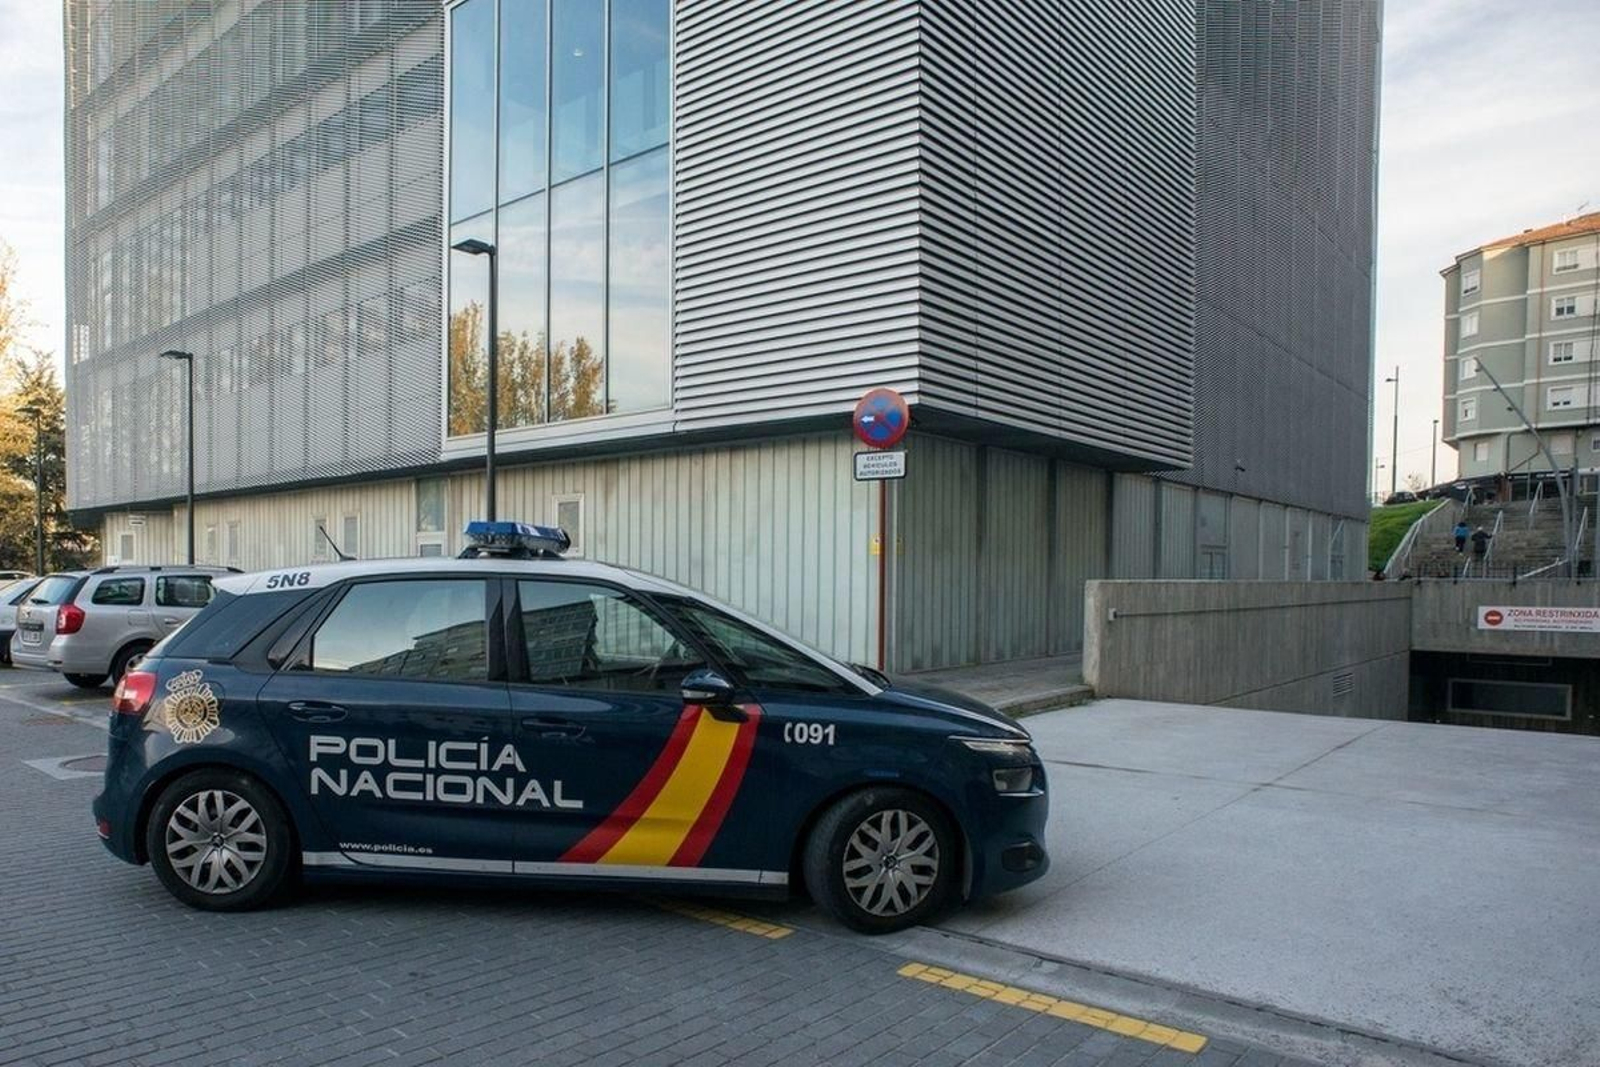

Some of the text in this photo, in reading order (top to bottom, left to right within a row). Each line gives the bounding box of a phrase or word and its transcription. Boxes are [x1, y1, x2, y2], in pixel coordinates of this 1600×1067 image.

[266, 571, 311, 589] 5N8
[1507, 609, 1534, 618] ZONA
[793, 722, 835, 746] 091
[309, 735, 527, 773] POLICÍA
[310, 767, 584, 809] NACIONAL
[339, 842, 434, 855] www.policia.es
